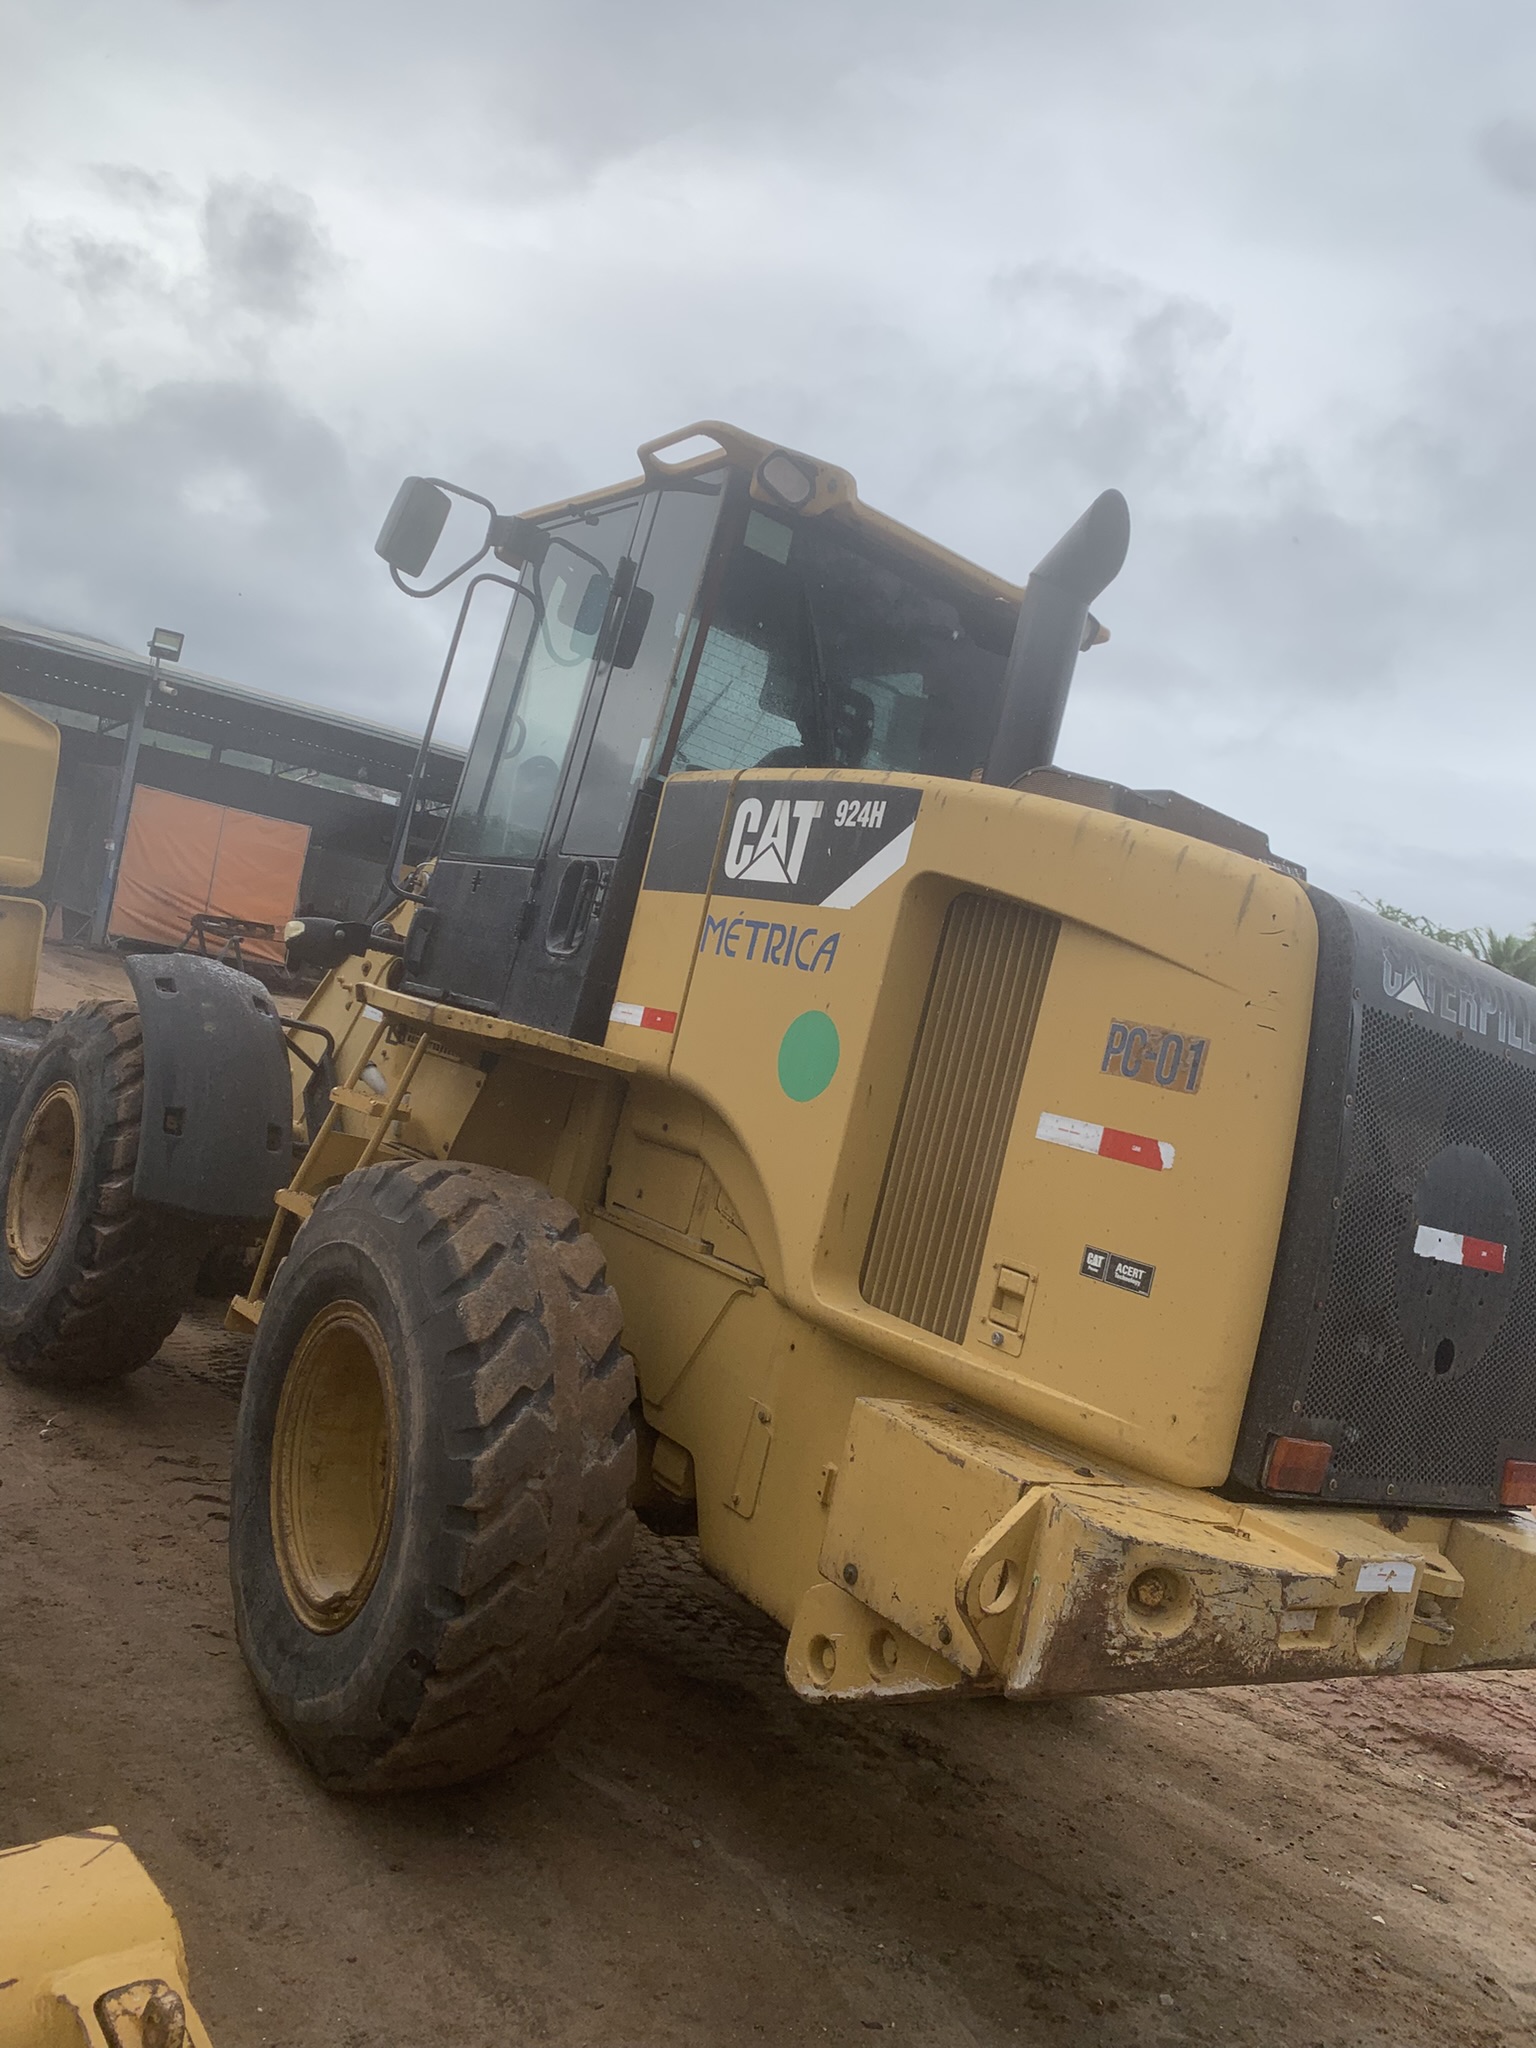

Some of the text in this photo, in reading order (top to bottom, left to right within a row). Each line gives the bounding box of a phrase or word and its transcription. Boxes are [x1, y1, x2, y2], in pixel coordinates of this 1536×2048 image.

[834, 799, 887, 829] 924H
[725, 797, 825, 885] CAT
[700, 911, 841, 974] MÉTRICA
[1101, 1022, 1206, 1091] PC-01
[1087, 1252, 1105, 1268] CAT
[1115, 1262, 1146, 1280] ACERT
